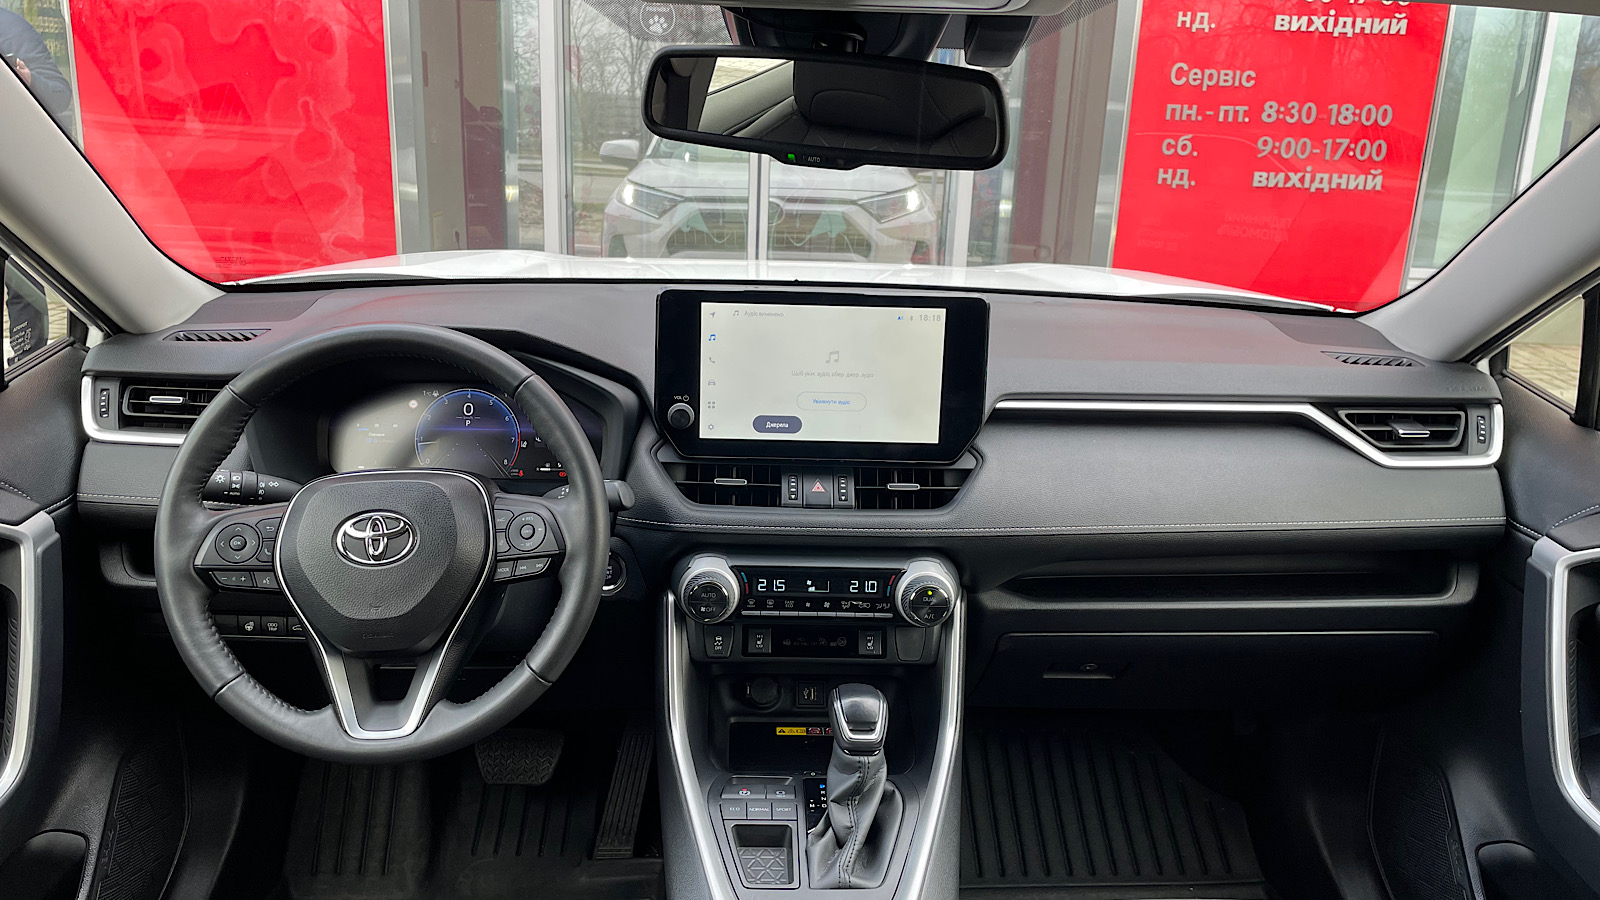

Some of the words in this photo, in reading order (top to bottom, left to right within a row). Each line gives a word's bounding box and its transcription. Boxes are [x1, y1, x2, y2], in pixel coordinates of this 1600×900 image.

[1176, 11, 1216, 33] нд.
[1273, 9, 1408, 37] вихідний
[1170, 62, 1256, 91] Сервіс
[1161, 134, 1198, 157] сб.
[1256, 135, 1388, 162] 9:00-17:00
[1157, 168, 1196, 189] нд.
[1252, 165, 1384, 193] вихідний
[919, 313, 942, 322] 18:18
[463, 402, 474, 416] 0
